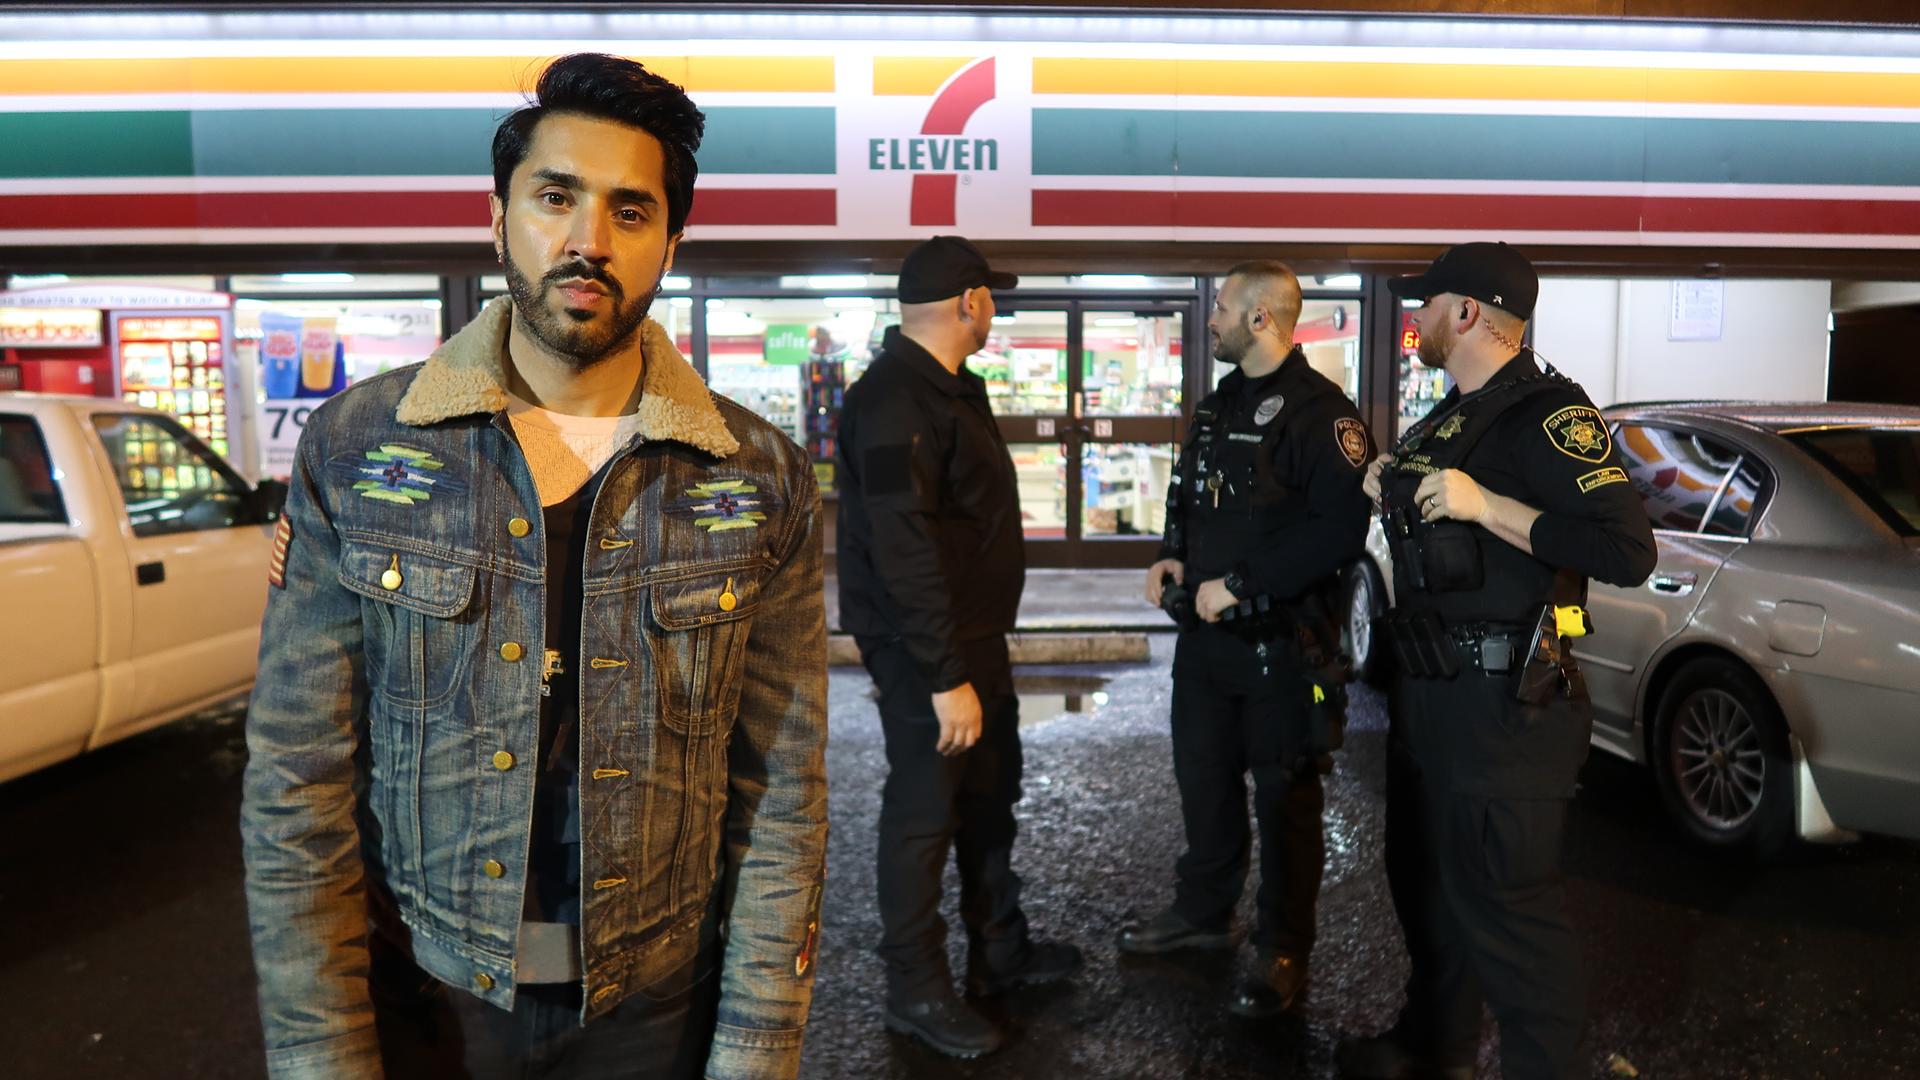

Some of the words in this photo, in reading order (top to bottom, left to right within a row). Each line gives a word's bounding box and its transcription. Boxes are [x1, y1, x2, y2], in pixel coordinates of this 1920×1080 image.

[873, 56, 996, 226] 7
[82, 297, 105, 305] WAY
[769, 332, 806, 348] coffee
[1548, 409, 1596, 430] SHERIFF
[1597, 470, 1610, 478] LAW
